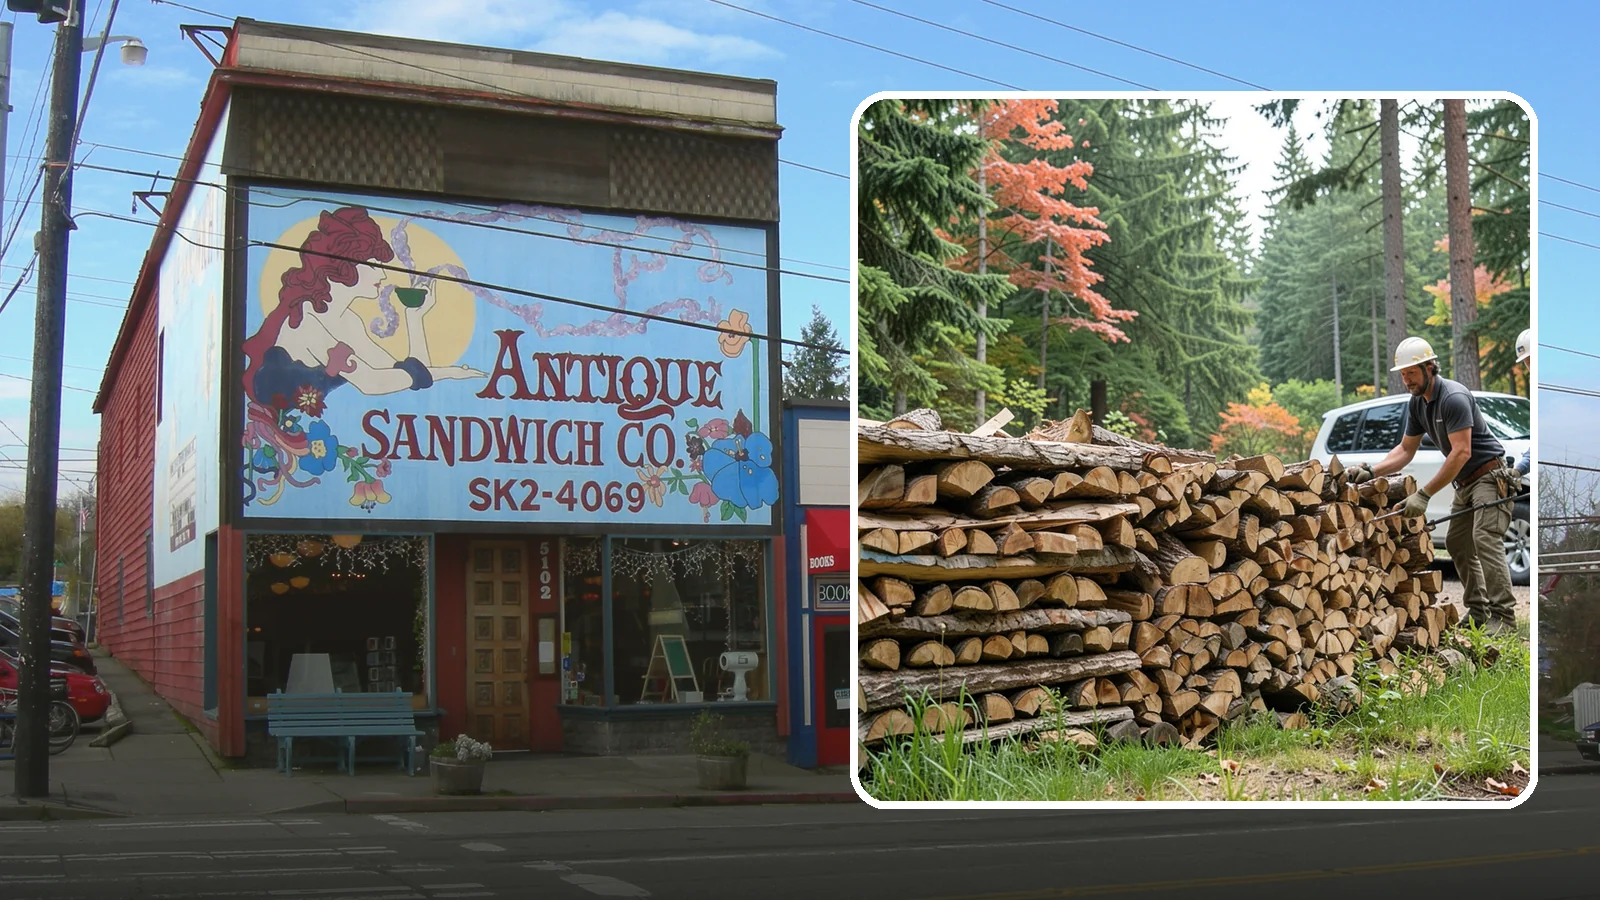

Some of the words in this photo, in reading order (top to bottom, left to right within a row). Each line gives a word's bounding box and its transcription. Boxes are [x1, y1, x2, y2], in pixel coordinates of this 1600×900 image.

[475, 328, 724, 421] ANTIQUE
[362, 408, 605, 467] SANDWICH
[617, 421, 685, 469] CO.
[468, 476, 646, 513] SK2-4069
[540, 542, 551, 599] 5102
[809, 555, 834, 569] BOOKS
